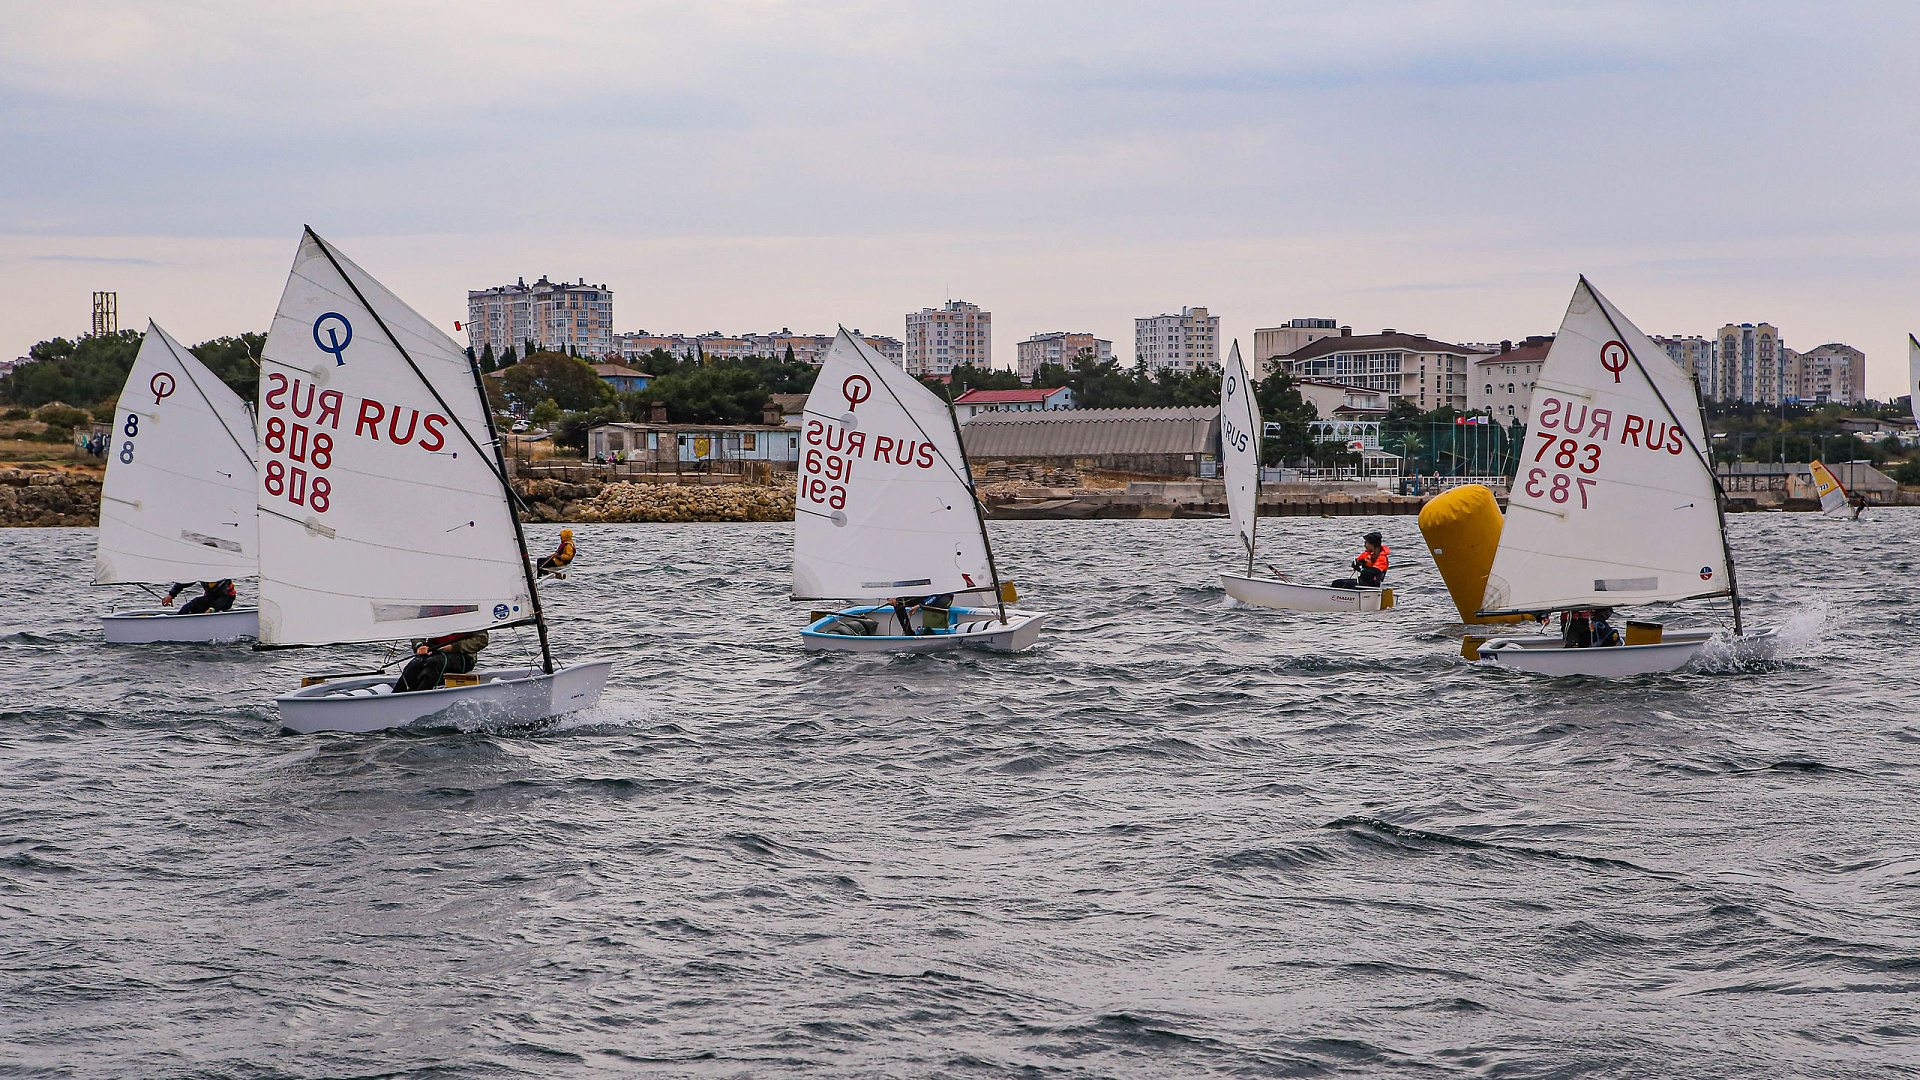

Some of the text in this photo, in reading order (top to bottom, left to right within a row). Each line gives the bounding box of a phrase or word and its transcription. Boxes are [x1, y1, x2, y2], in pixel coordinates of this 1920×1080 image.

[125, 414, 138, 437] 8
[265, 417, 333, 469] 808
[355, 398, 449, 451] RUS
[1226, 421, 1248, 452] RUS
[1621, 414, 1684, 455] RUS
[806, 450, 852, 483] 691
[874, 436, 935, 468] RUS
[1534, 432, 1601, 473] 783
